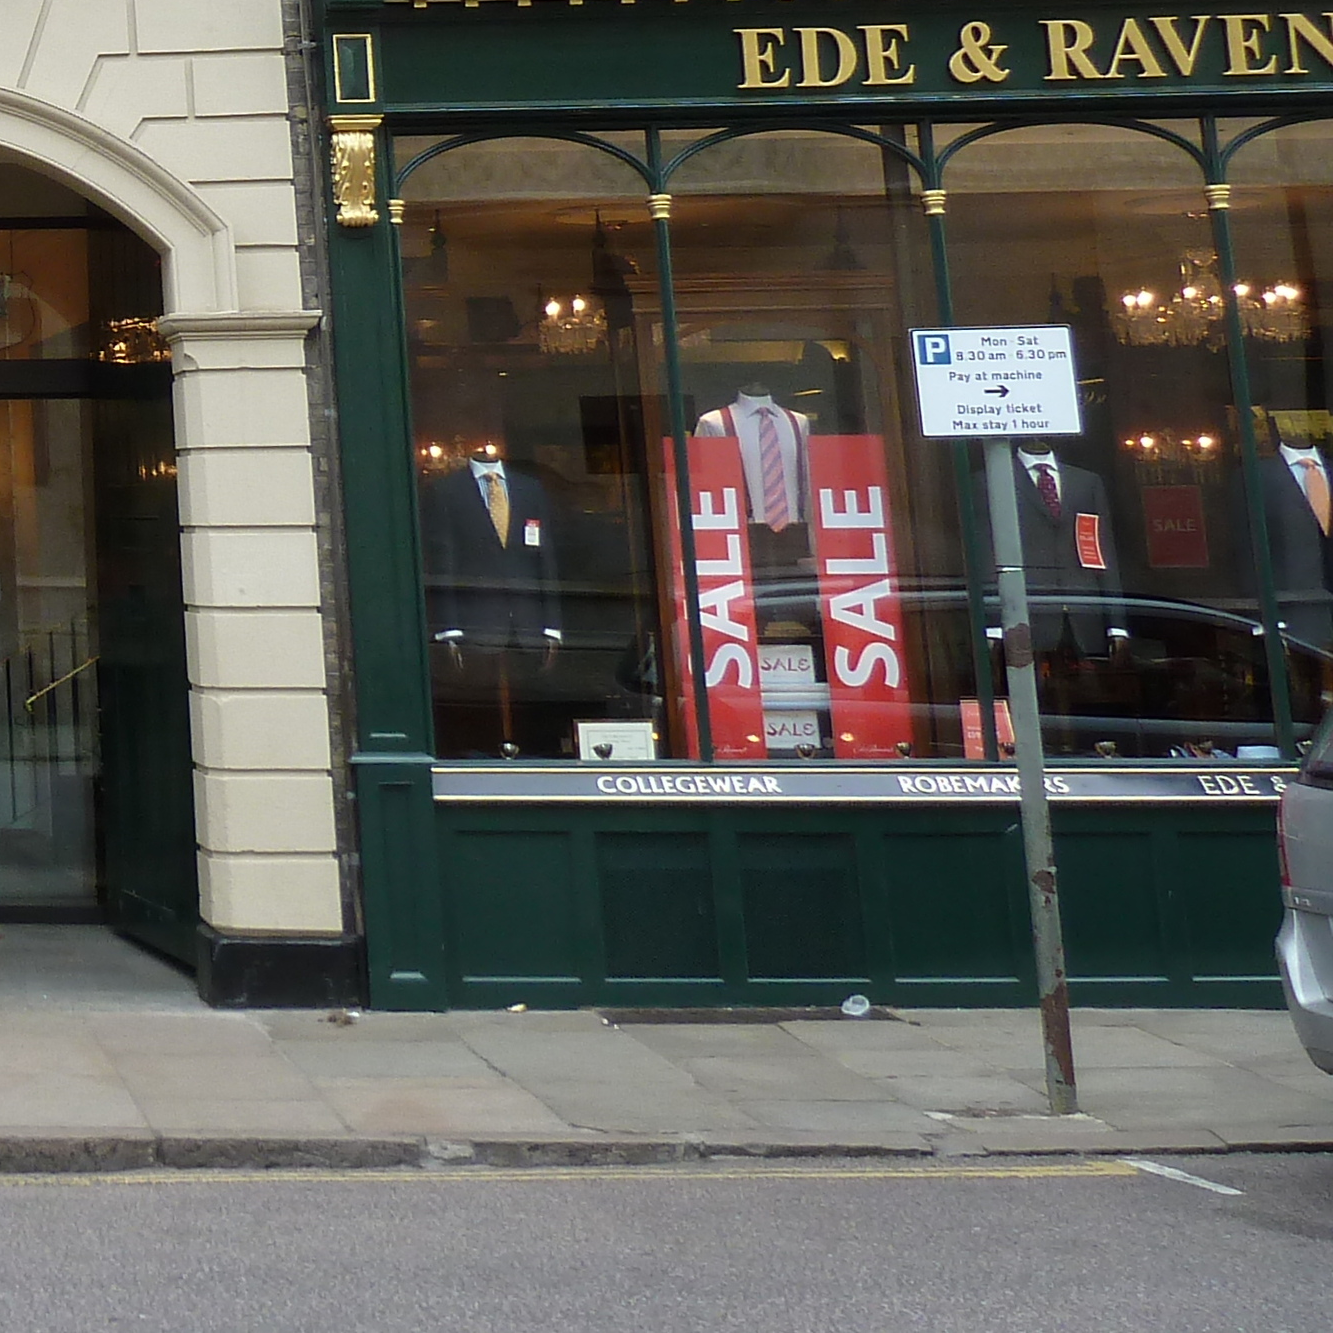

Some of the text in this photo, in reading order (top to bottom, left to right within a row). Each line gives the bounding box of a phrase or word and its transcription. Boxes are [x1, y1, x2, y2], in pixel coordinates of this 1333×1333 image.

[733, 13, 1333, 89] EDE & RAVEN
[981, 336, 1007, 347] Mon
[1017, 335, 1039, 346] Sat
[924, 337, 946, 363] P
[956, 351, 985, 361] 8.30
[989, 352, 1006, 360] am
[1016, 350, 1045, 360] 6.30
[1048, 351, 1067, 360] pm
[949, 370, 1043, 382] Pay at machine
[957, 403, 1043, 416] Display ticket
[953, 419, 1050, 431] Max stay 1 hour
[1152, 518, 1197, 532] SALE
[675, 487, 753, 689] SALE
[818, 486, 900, 689] SALE
[761, 657, 811, 672] SALE
[767, 722, 815, 736] SALE
[596, 775, 783, 794] COLLEGEWEAR
[896, 775, 1071, 794] ROBEMAKRS
[1197, 775, 1261, 794] EDE
